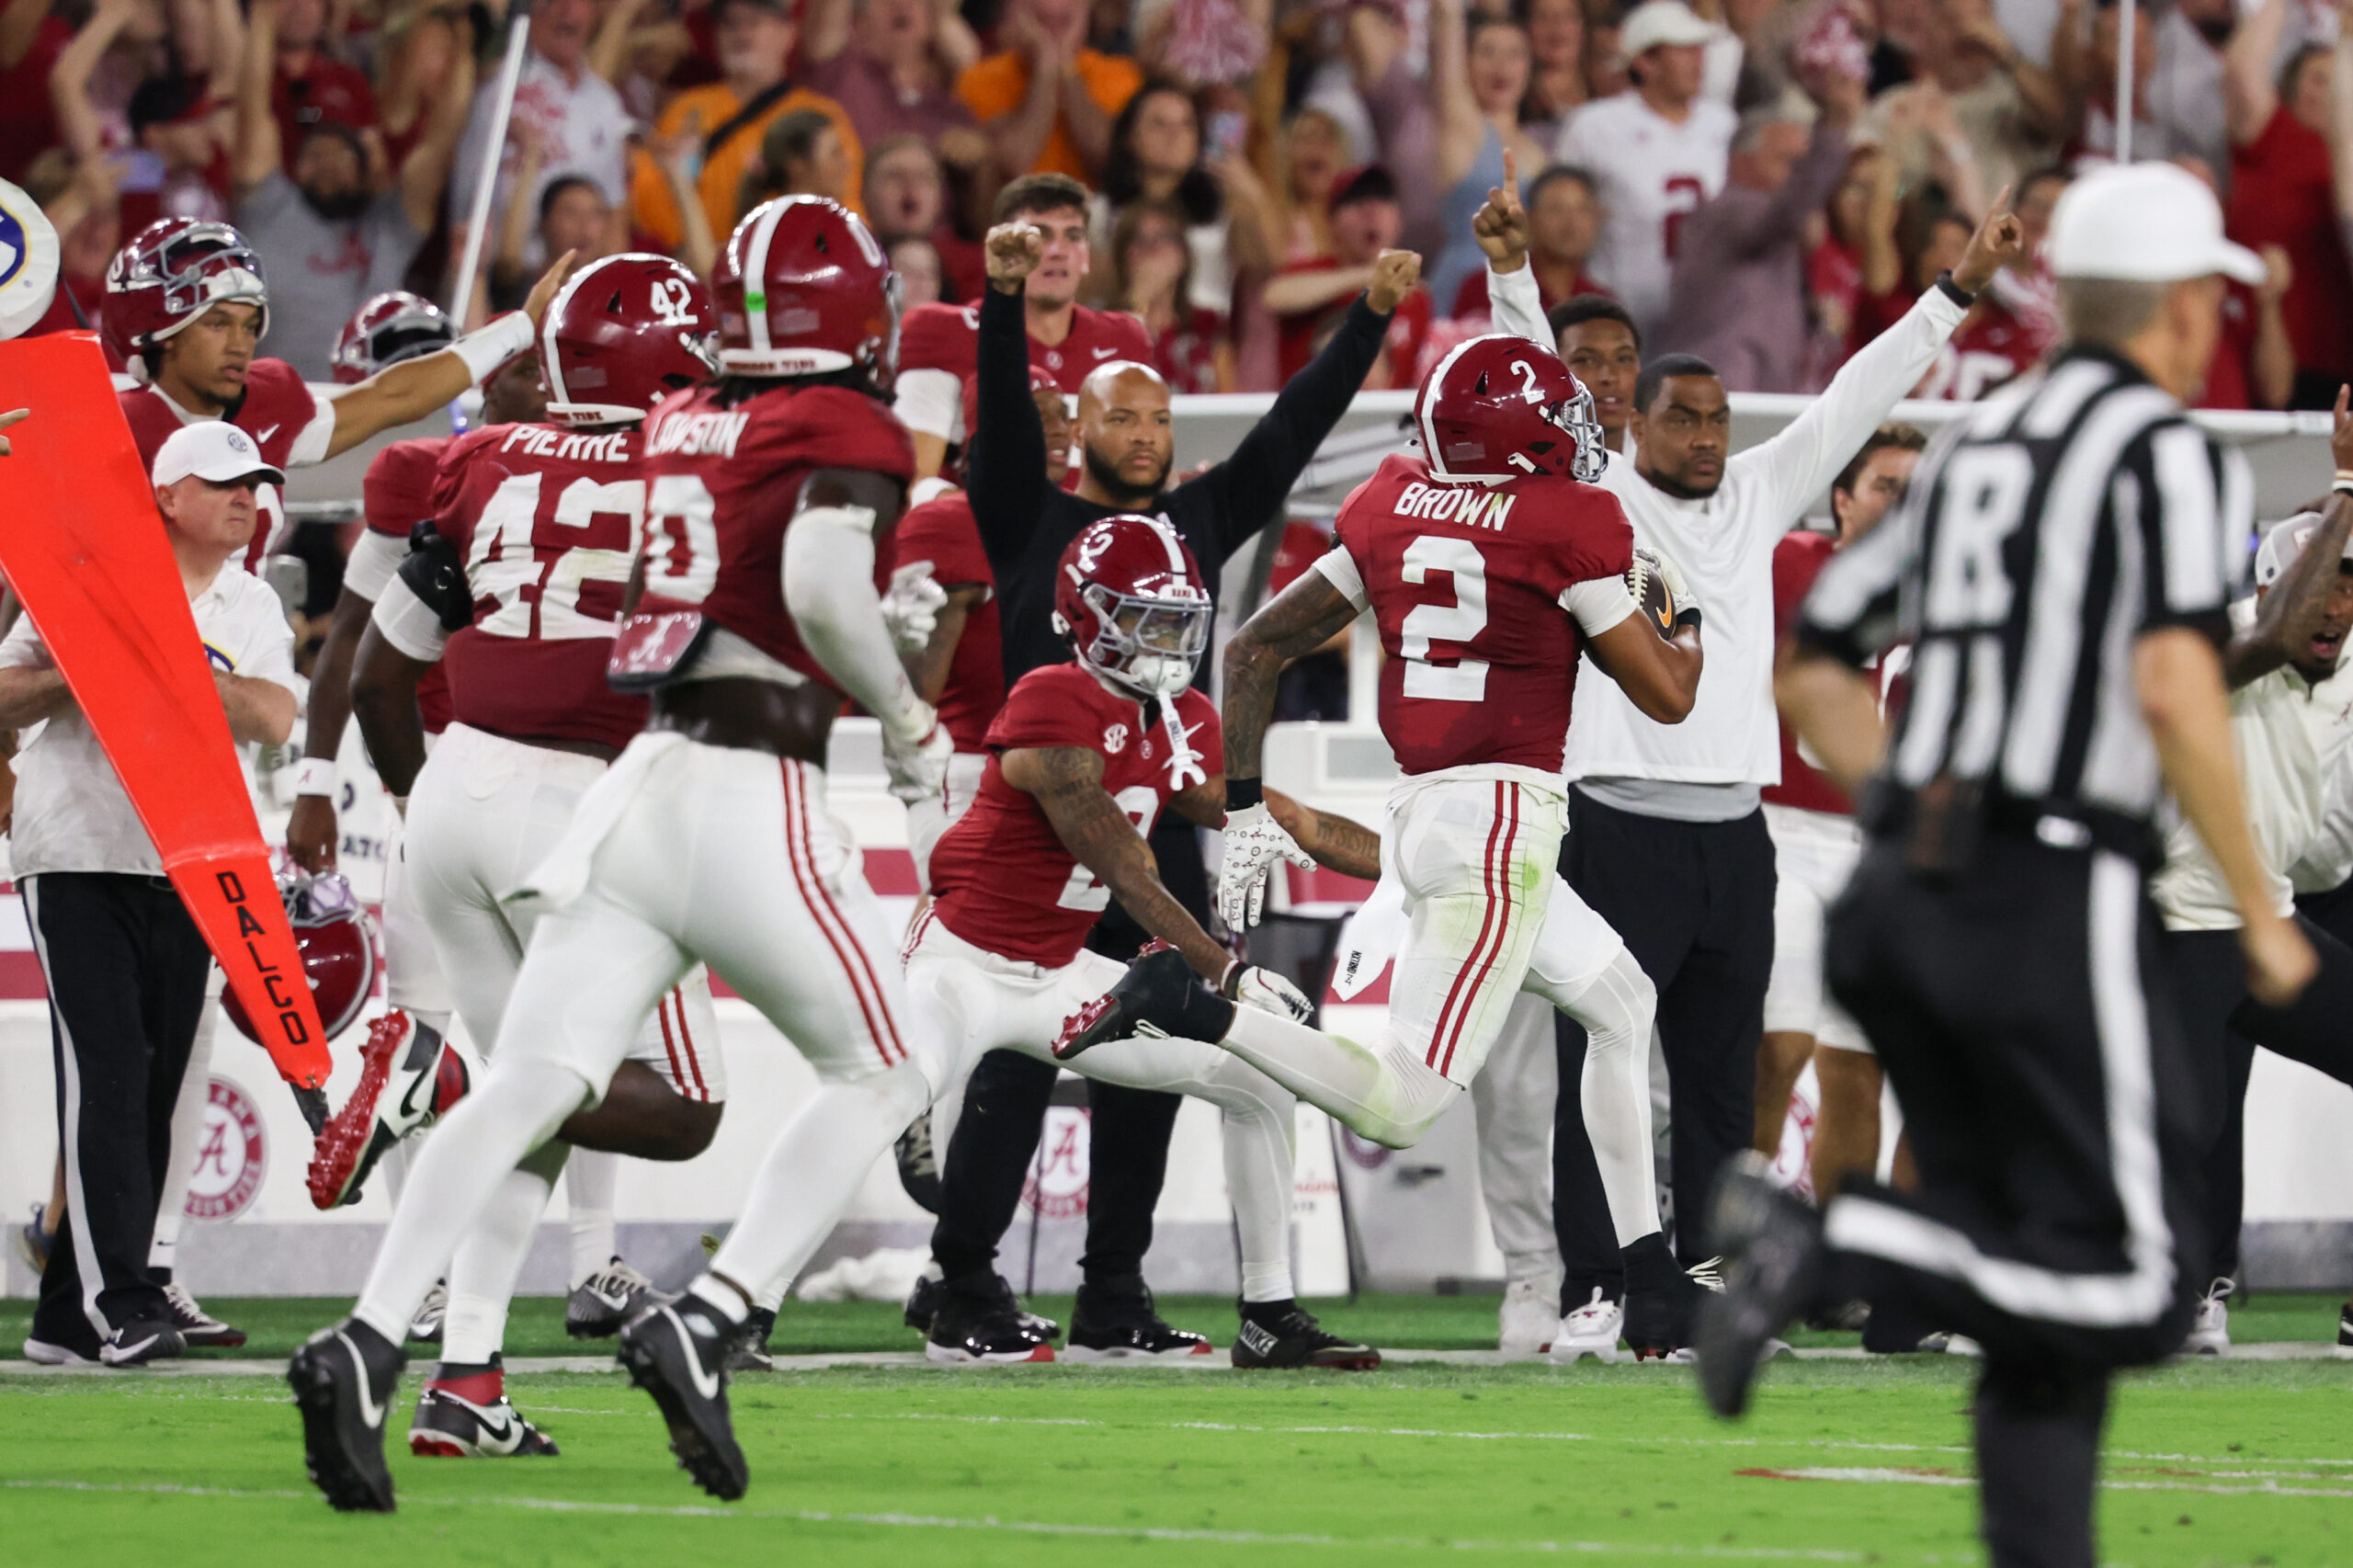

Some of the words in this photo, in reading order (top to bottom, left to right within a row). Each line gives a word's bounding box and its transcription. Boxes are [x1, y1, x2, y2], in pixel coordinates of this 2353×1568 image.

[651, 278, 699, 325] 42
[1510, 359, 1546, 405] 2
[501, 425, 630, 462] PIERRE
[645, 411, 751, 459] LAWSON
[1393, 481, 1518, 532] BROWN
[464, 472, 646, 640] 42
[646, 474, 722, 605] 0
[1077, 532, 1114, 574] 2
[1926, 442, 2035, 626] R
[1400, 535, 1491, 702] 2
[216, 870, 318, 1045] DALCO
